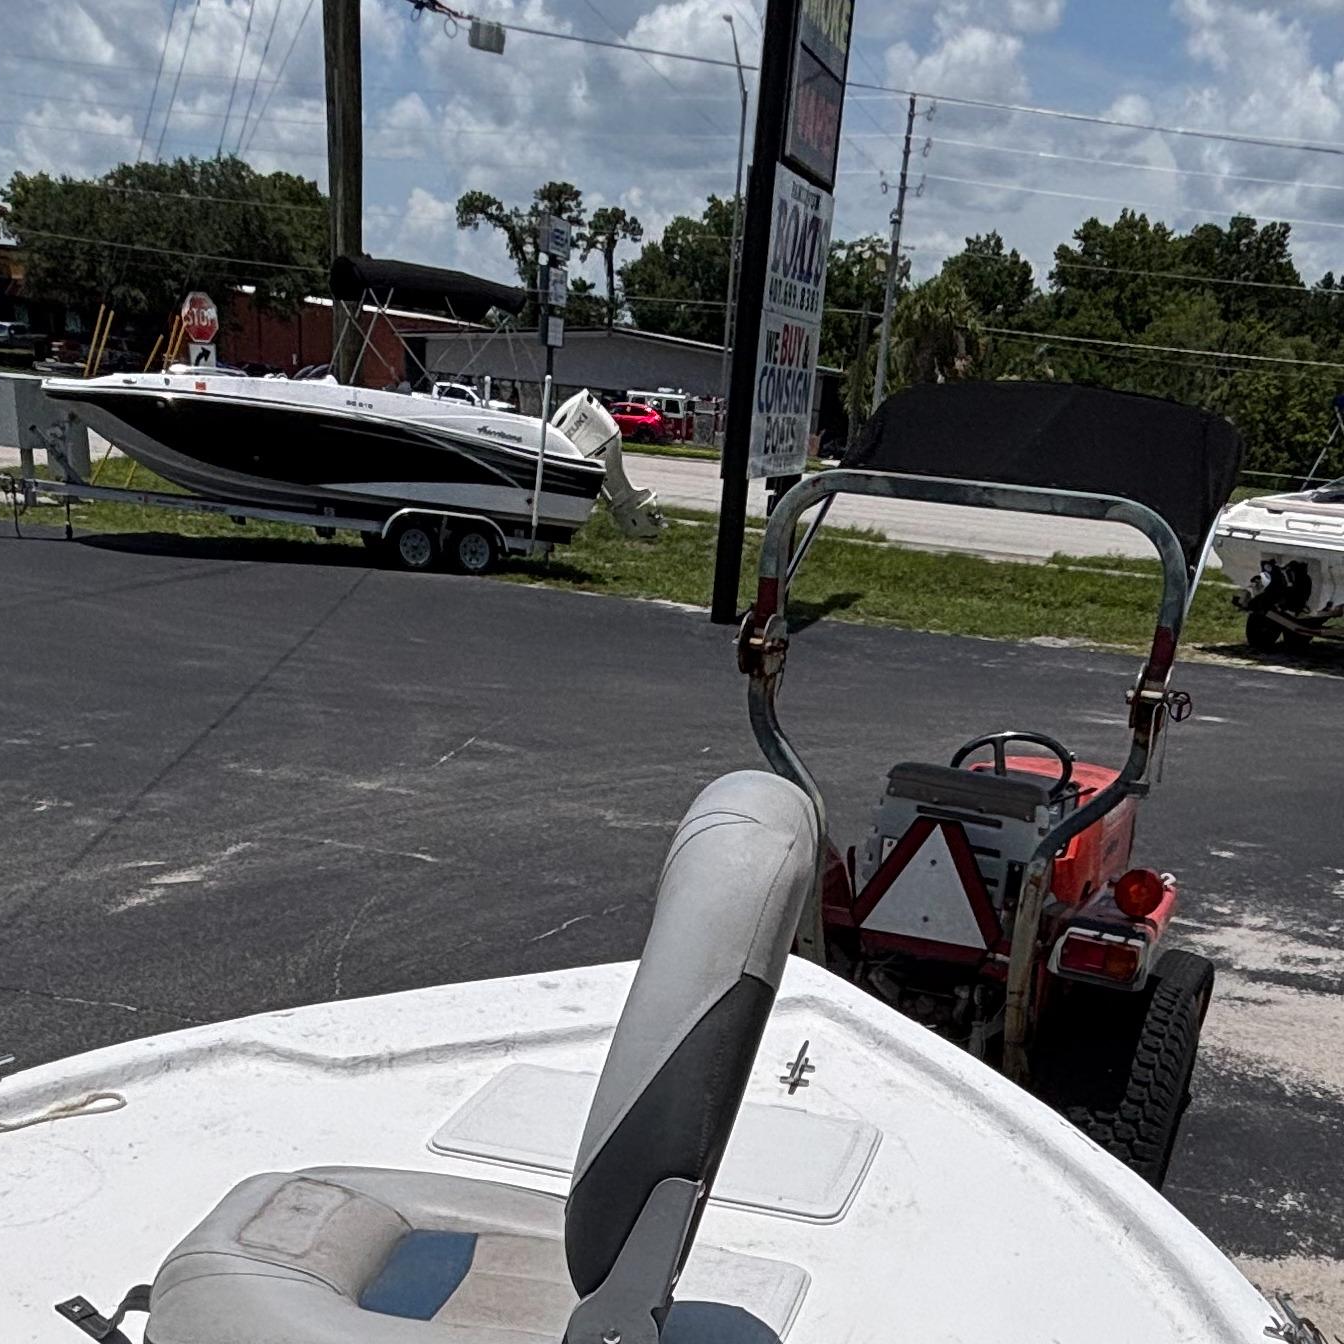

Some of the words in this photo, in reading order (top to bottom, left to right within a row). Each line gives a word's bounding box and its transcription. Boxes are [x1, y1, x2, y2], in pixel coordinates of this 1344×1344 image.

[771, 197, 832, 288] BOATS
[186, 307, 216, 326] STOP
[765, 329, 781, 364] WE
[779, 323, 805, 368] BUY
[802, 334, 810, 369] &
[757, 365, 813, 416] CONSIGN
[763, 416, 797, 455] BOATS
